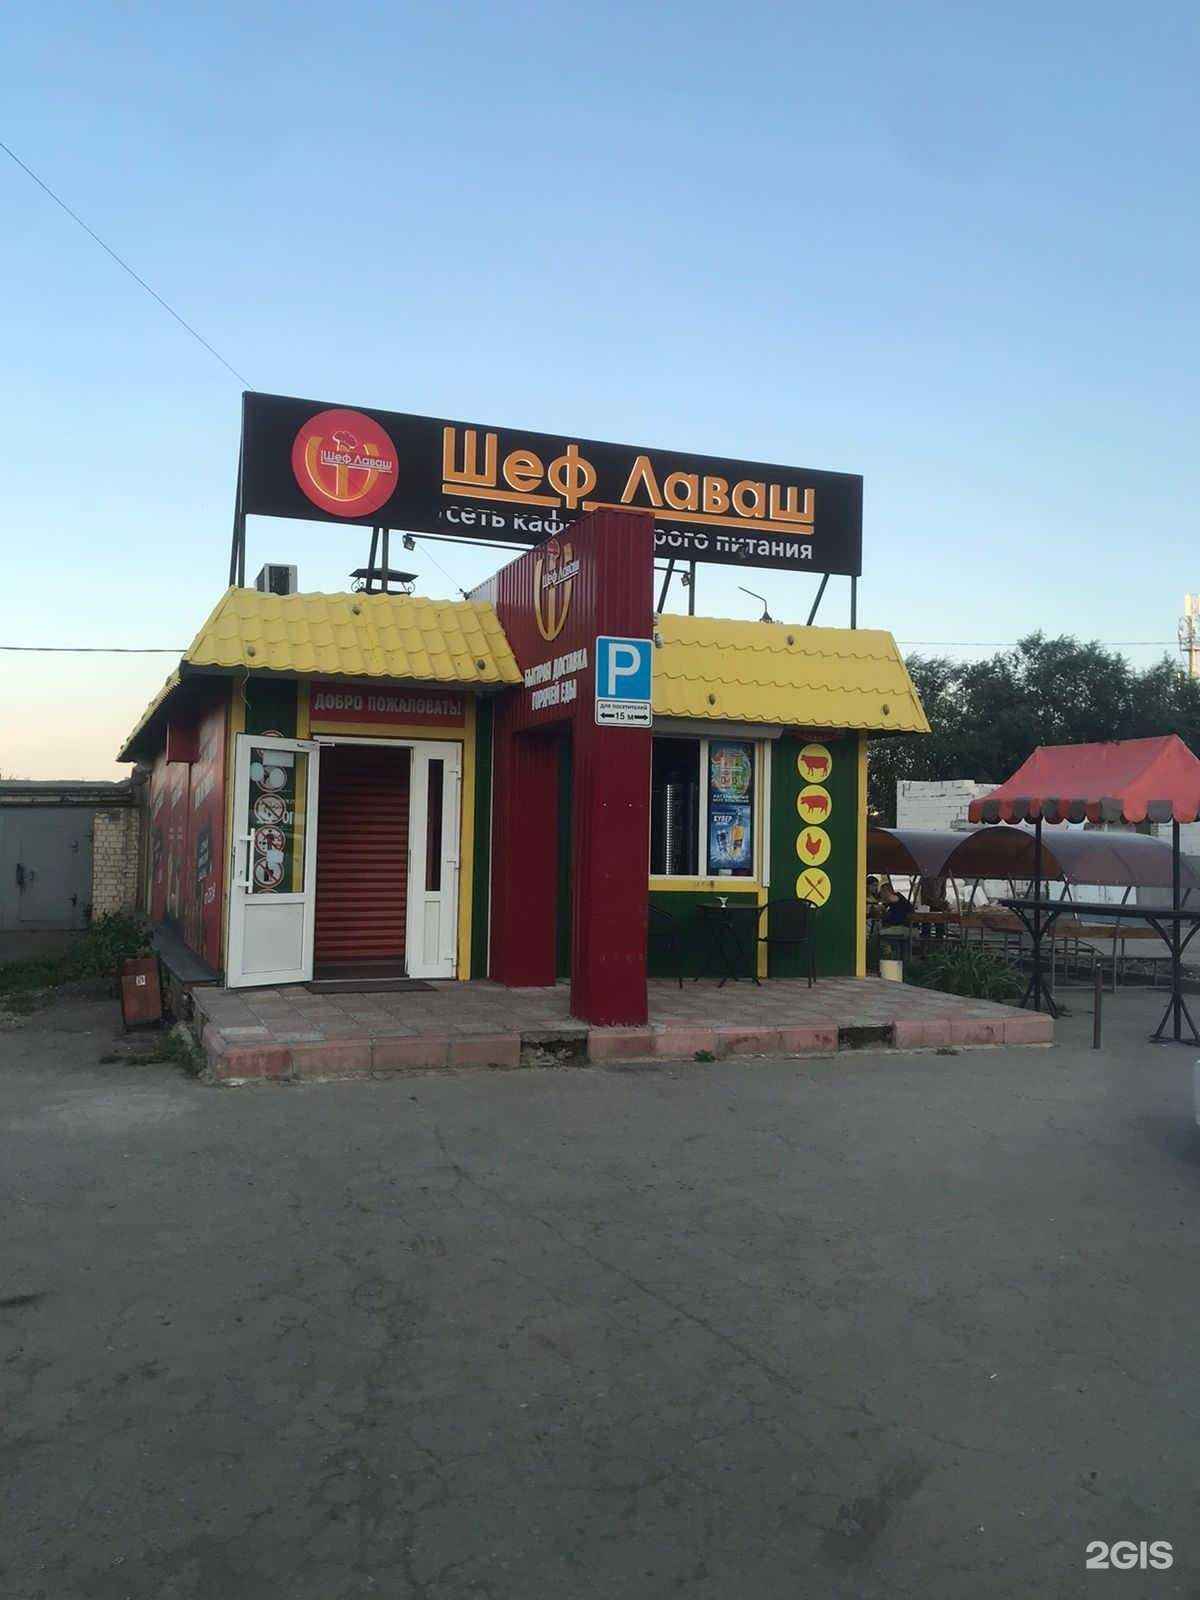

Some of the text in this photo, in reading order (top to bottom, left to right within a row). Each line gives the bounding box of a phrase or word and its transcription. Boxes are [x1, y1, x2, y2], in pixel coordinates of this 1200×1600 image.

[322, 449, 392, 470] Шеф Лаваш
[442, 426, 816, 523] Шеф Лаваш
[446, 506, 505, 527] сеть
[716, 535, 812, 559] питания
[608, 643, 641, 696] P
[314, 693, 363, 710] ДОБРО
[615, 712, 625, 720] 15
